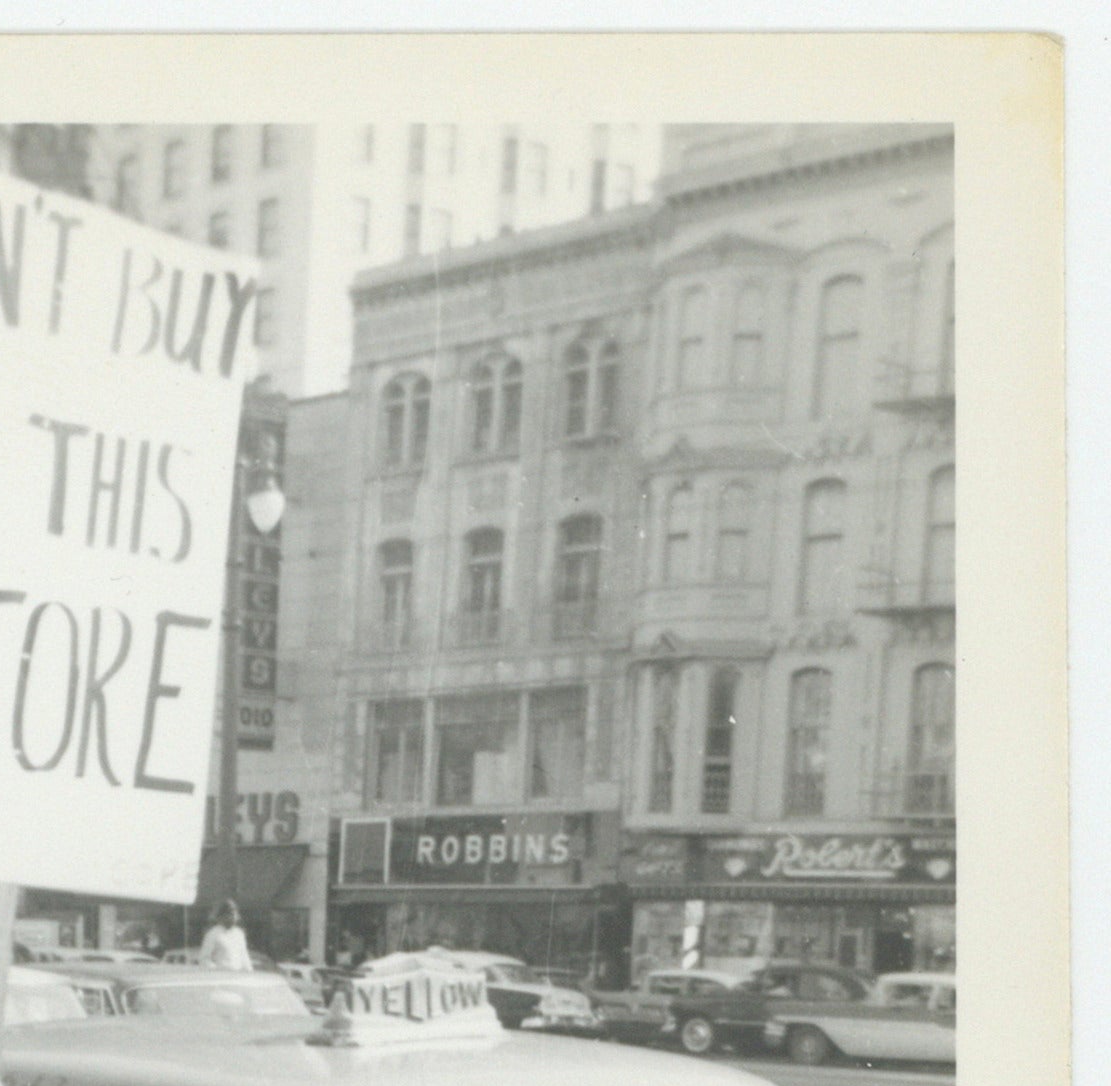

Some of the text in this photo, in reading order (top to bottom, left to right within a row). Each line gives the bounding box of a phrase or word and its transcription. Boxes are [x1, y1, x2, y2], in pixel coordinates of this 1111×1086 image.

[111, 247, 257, 378] BUY
[29, 412, 192, 563] THIS
[416, 833, 571, 865] ROBBINS
